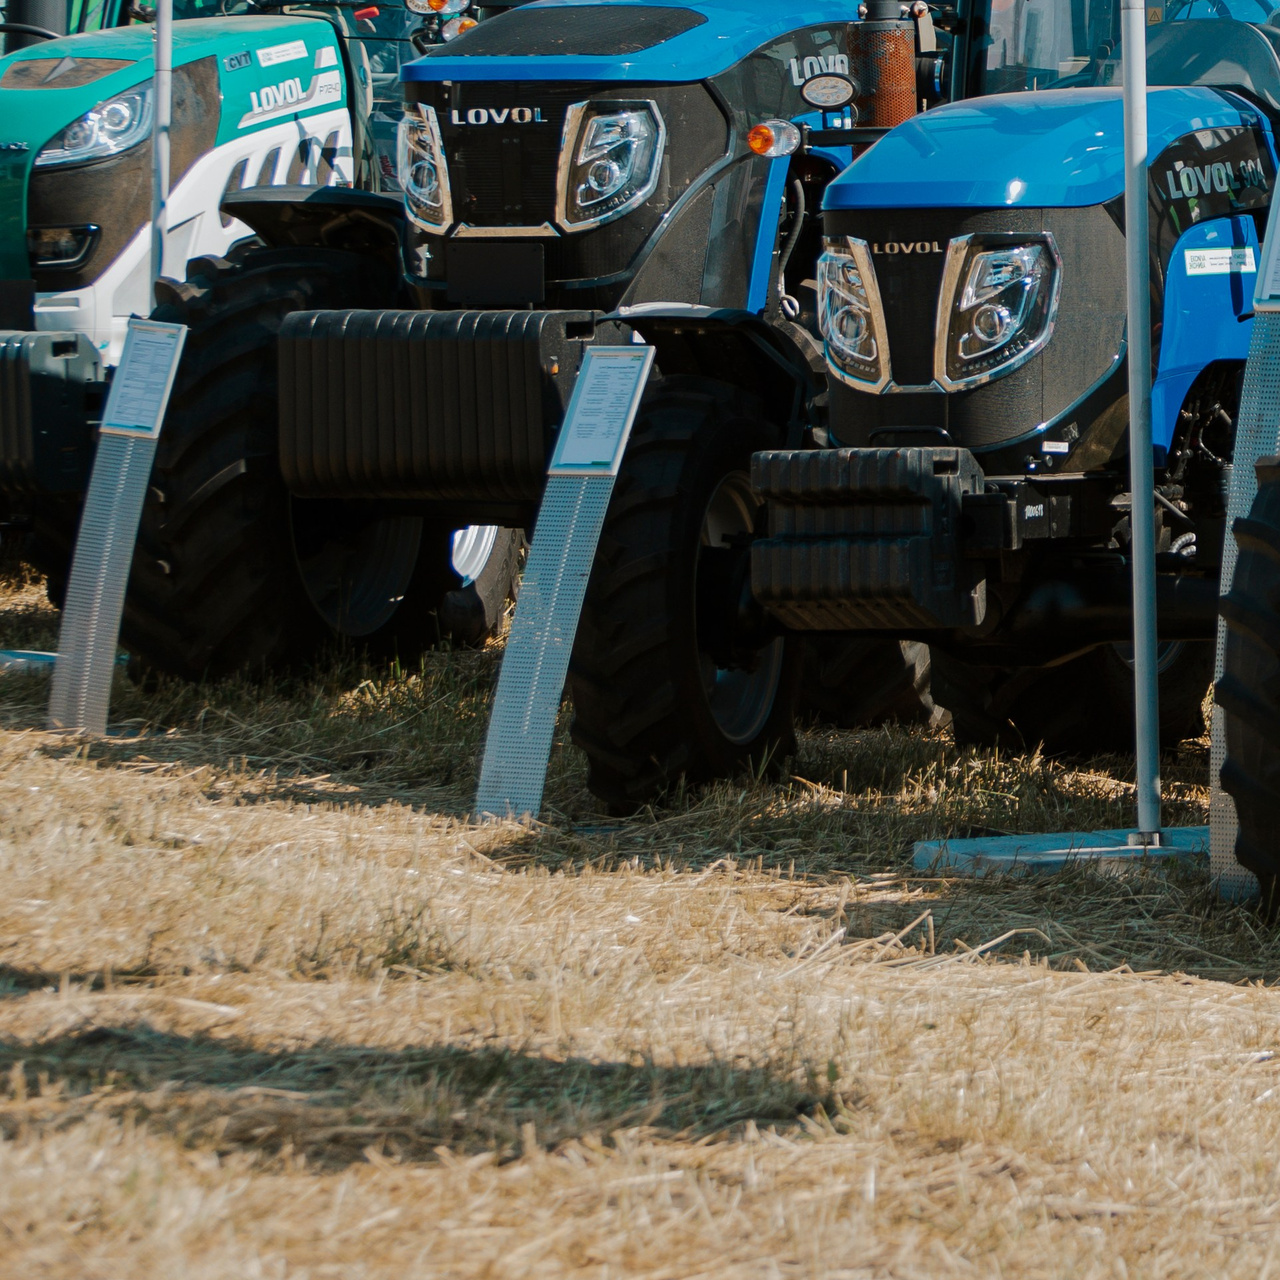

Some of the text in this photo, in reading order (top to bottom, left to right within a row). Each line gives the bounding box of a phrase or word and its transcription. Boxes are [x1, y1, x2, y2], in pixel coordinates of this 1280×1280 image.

[229, 52, 251, 70] CVT
[249, 77, 307, 115] LOVOL
[451, 106, 548, 125] LOVOL
[1166, 157, 1269, 200] LOVOL 904
[872, 242, 944, 255] LOVOL
